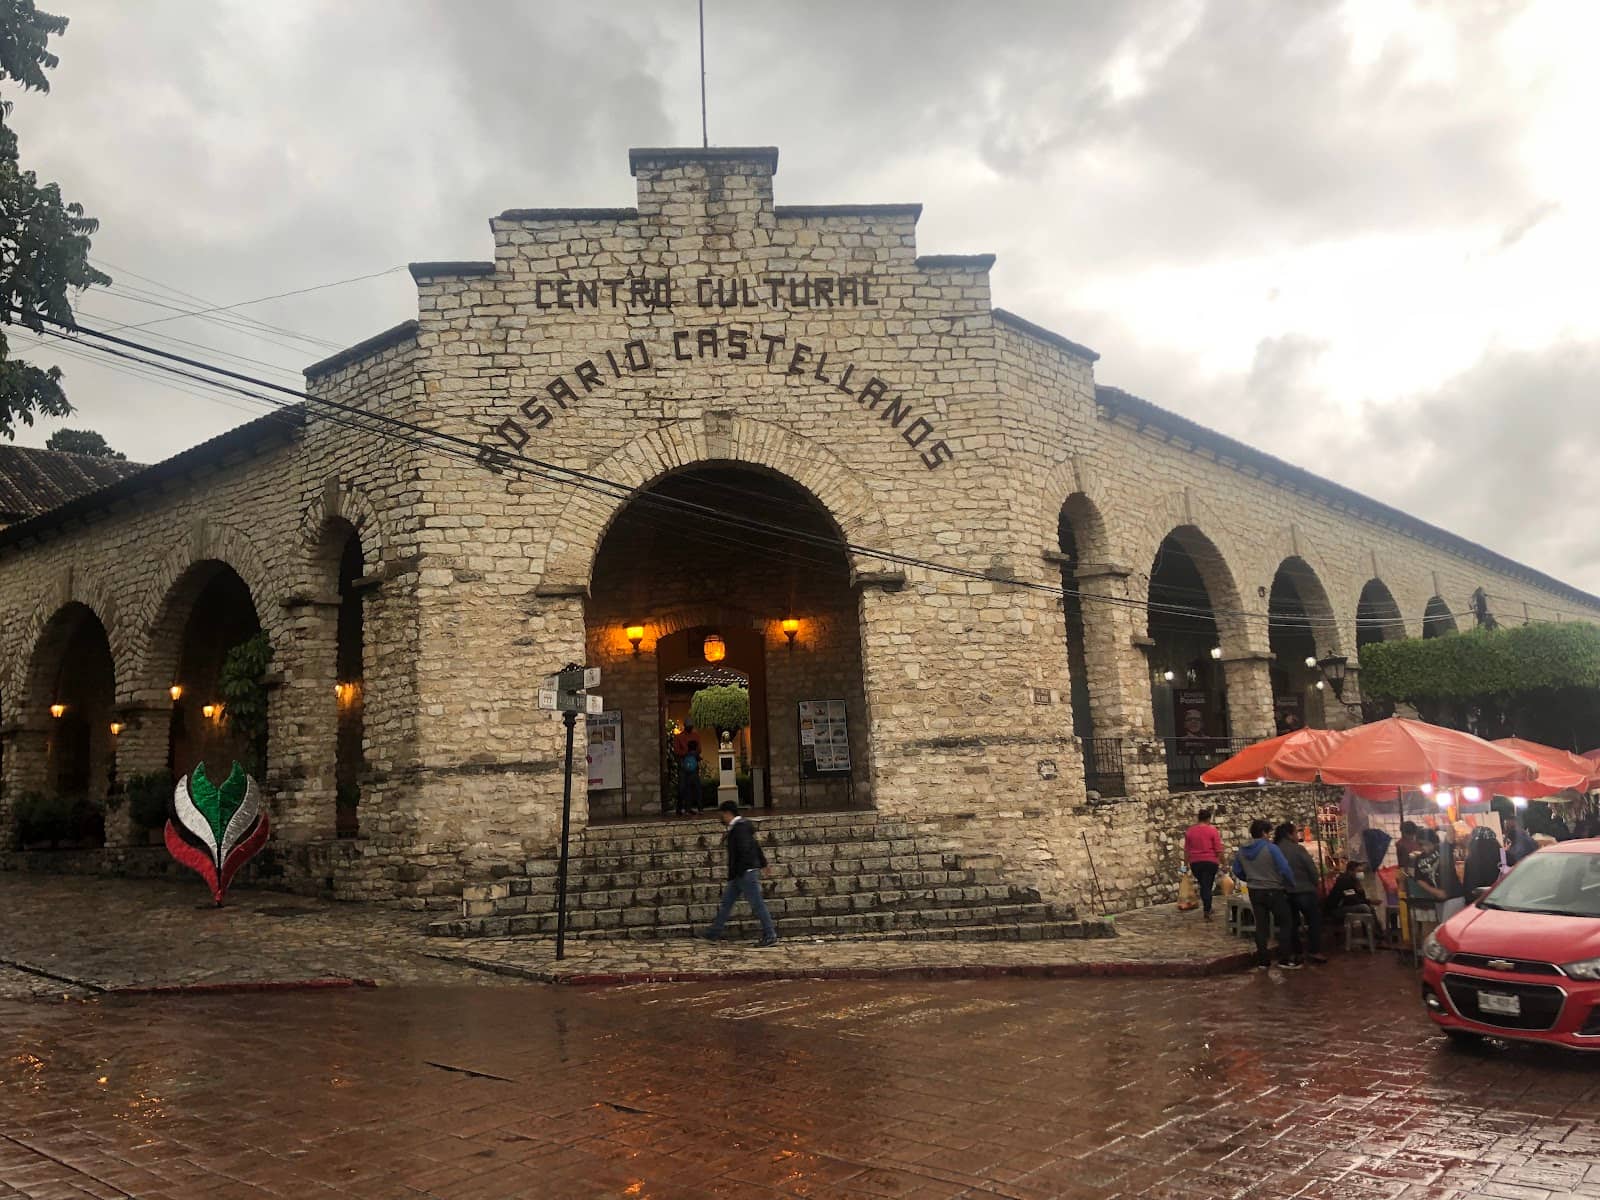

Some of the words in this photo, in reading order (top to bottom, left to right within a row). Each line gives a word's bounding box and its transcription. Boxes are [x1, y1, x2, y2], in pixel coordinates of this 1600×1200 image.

[535, 278, 671, 309] CENTRO
[697, 276, 878, 308] CULTURAL
[476, 339, 651, 475] ROSARIO
[673, 328, 953, 471] CASTELLANOS
